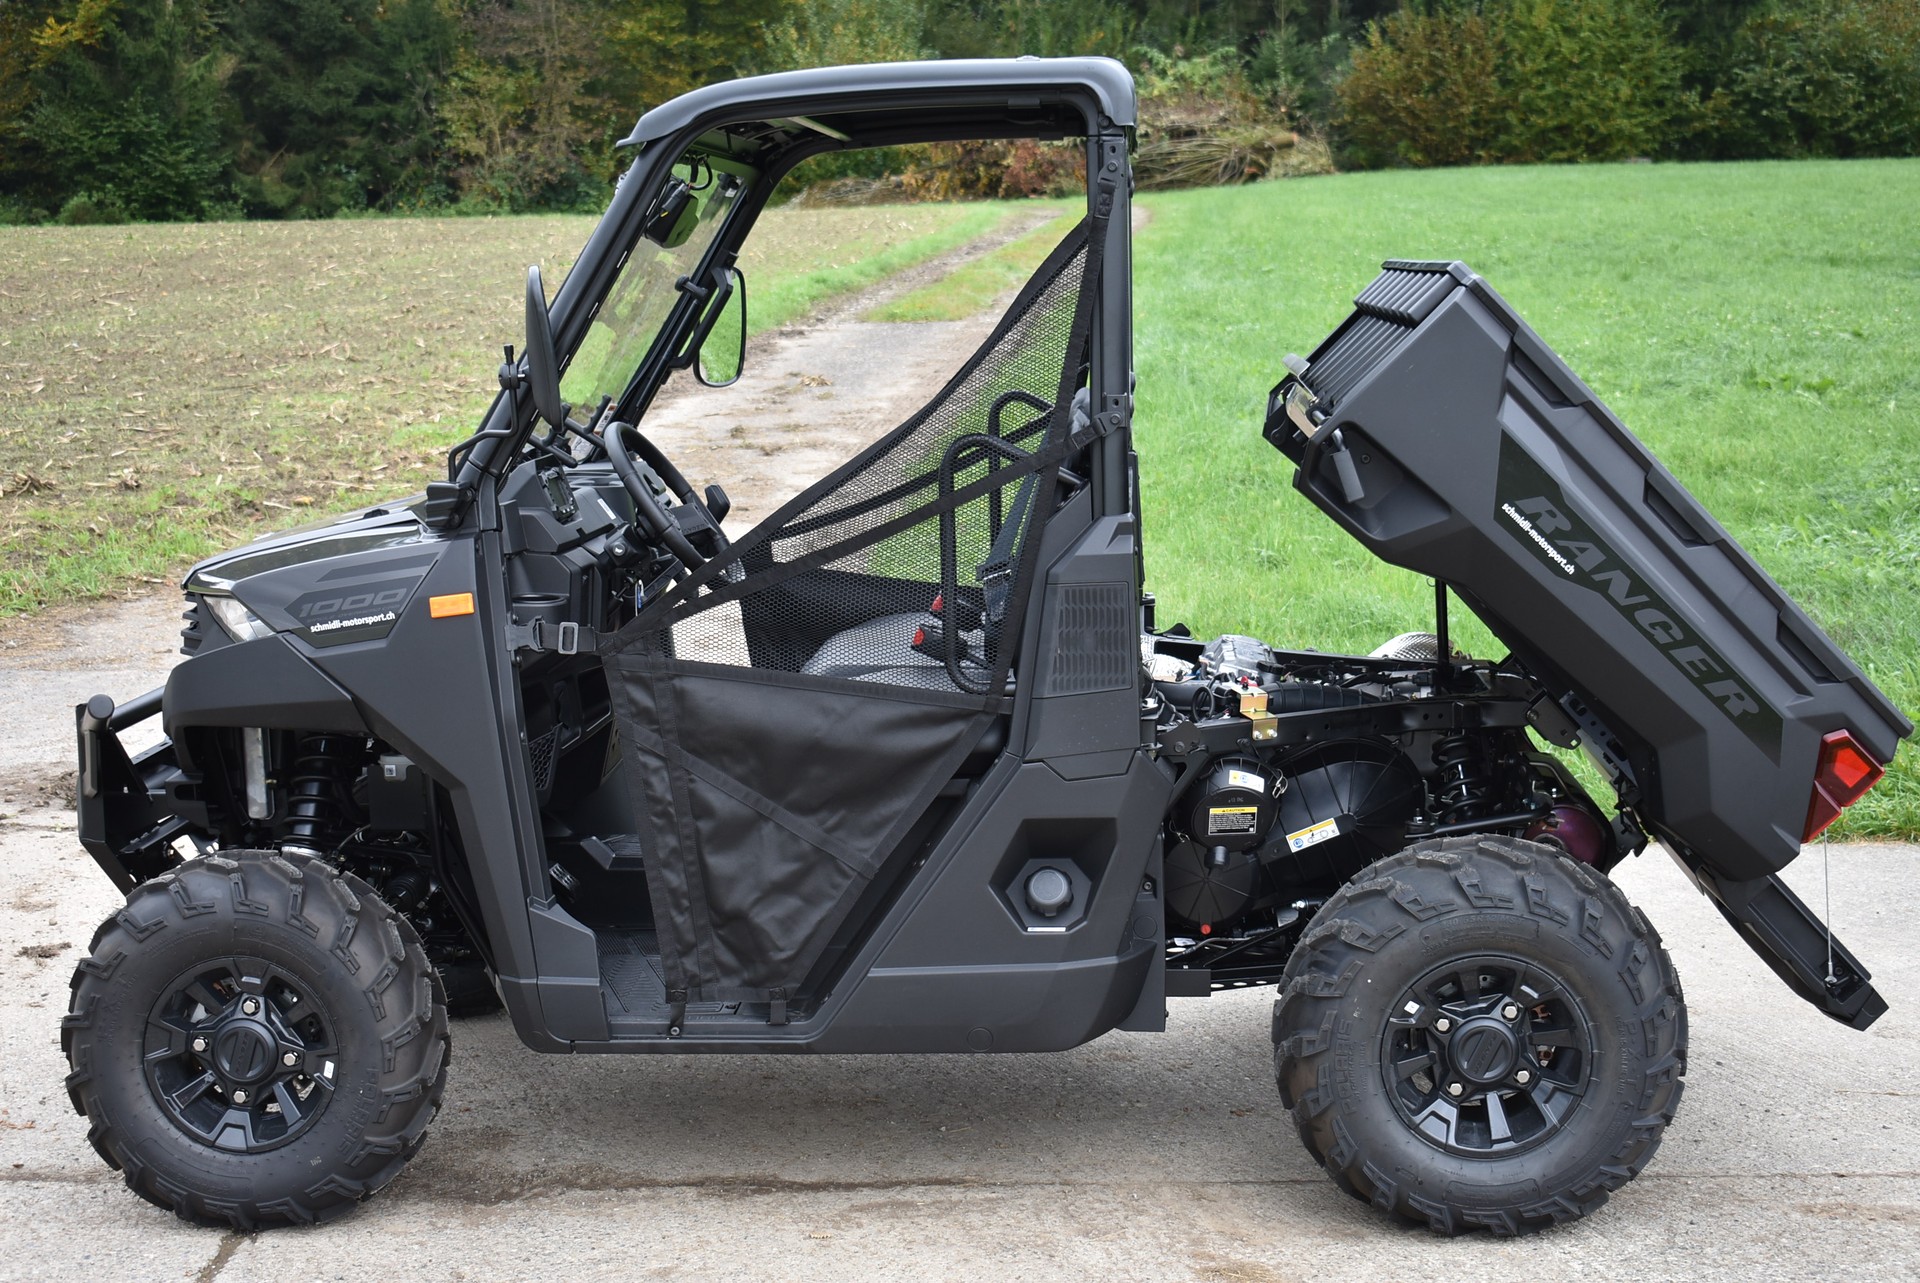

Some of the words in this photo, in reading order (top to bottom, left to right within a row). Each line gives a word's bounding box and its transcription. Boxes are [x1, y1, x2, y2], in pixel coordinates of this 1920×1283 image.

[1501, 502, 1575, 575] schmidli-motorsport.ch
[299, 588, 408, 618] 1000
[310, 610, 396, 633] schmidli-motorsport.ch
[1514, 496, 1760, 717] RANGER
[1335, 1018, 1357, 1116] POLARIS
